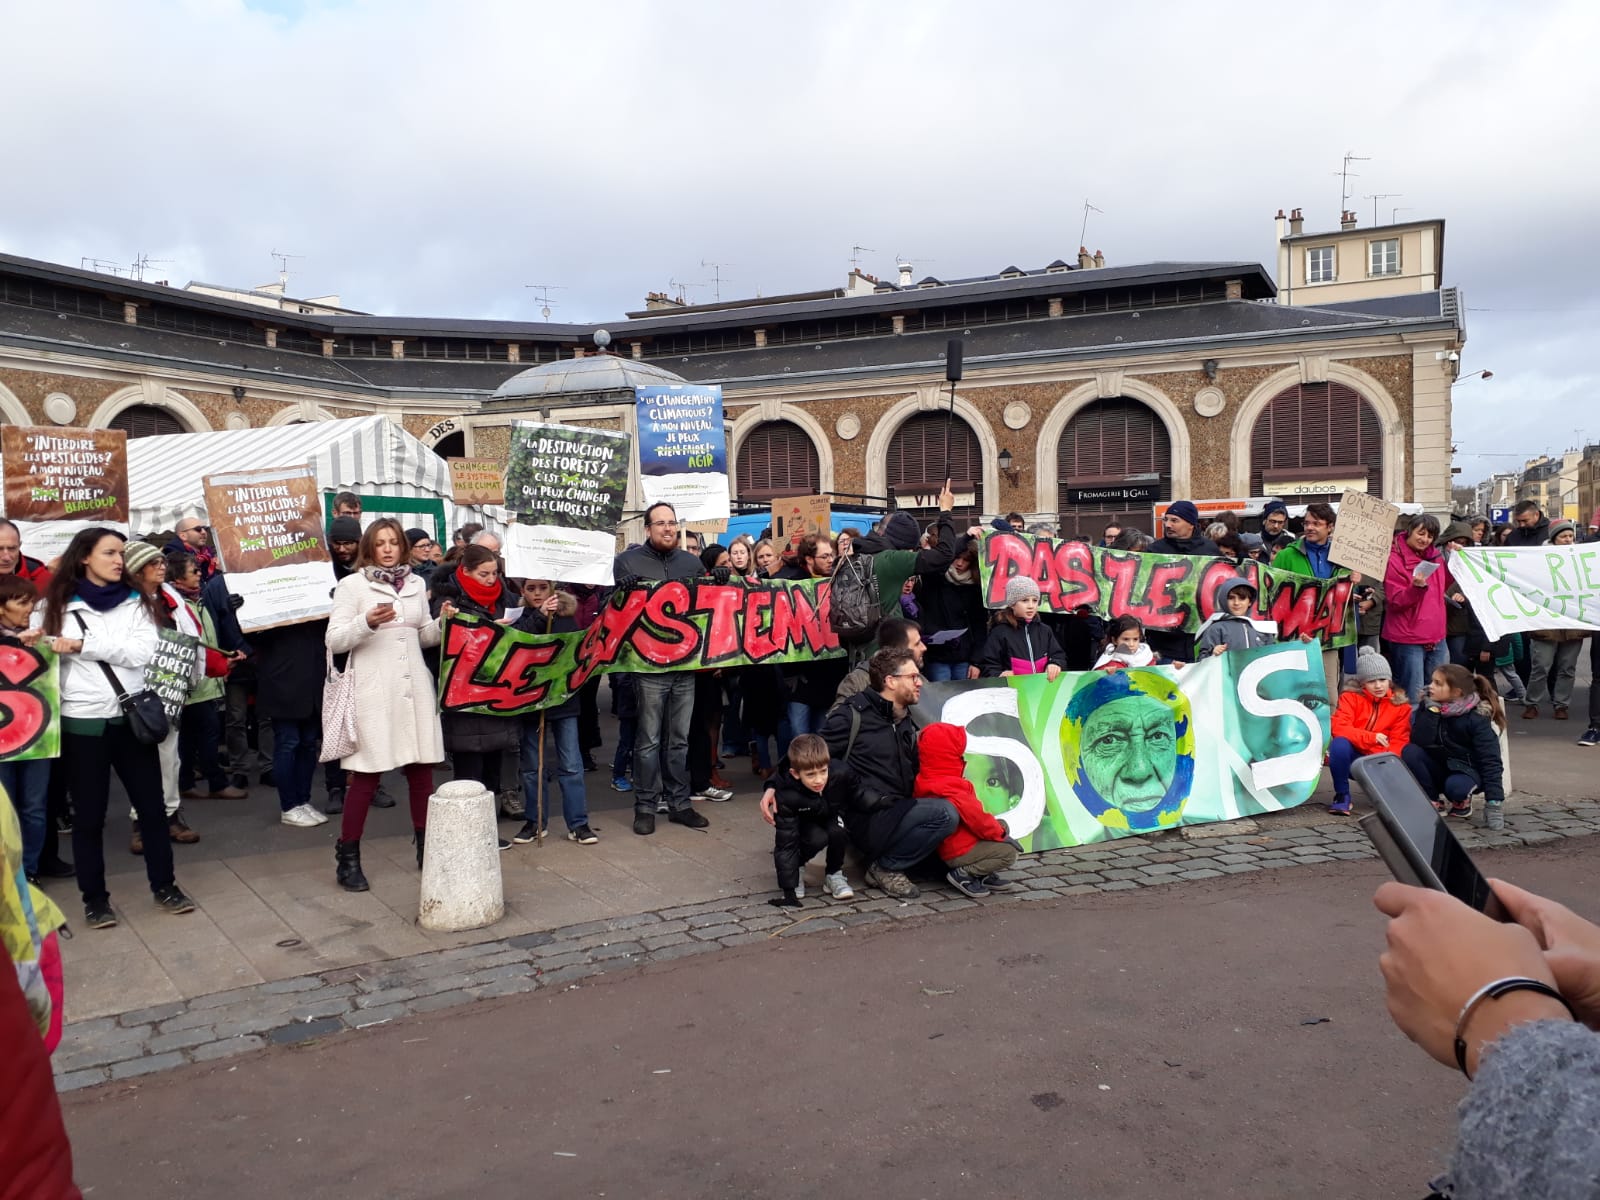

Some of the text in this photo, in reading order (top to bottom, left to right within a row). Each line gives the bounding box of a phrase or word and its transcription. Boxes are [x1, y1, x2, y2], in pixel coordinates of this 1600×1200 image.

[656, 394, 716, 407] CHANGEMENTS
[429, 419, 455, 440] DES
[661, 422, 679, 431] MON
[666, 433, 700, 444] JE PEUX
[538, 437, 614, 461] DESTRUCTION
[24, 453, 40, 462] LES
[532, 457, 551, 469] DES
[688, 454, 714, 468] AGIR
[39, 465, 61, 474] MON
[41, 475, 86, 488] JE PEUX
[534, 472, 560, 484] C'EST
[580, 478, 600, 489] MOI
[522, 485, 611, 505] QUI PEUX CHANGER
[1078, 491, 1121, 500] FROMAGERIE
[1294, 485, 1336, 494] daubos
[64, 495, 118, 514] BEAUCOUP
[228, 506, 242, 514] LES
[531, 499, 548, 510] LES
[1347, 494, 1366, 510] ON
[1371, 503, 1395, 519] EST
[243, 514, 263, 525] MON
[1493, 510, 1503, 520] P
[247, 523, 287, 536] JE PEUX
[271, 537, 319, 560] BEAUCOUP
[986, 531, 1101, 614] PAS
[1101, 555, 1193, 632] LE
[440, 618, 562, 711] LE
